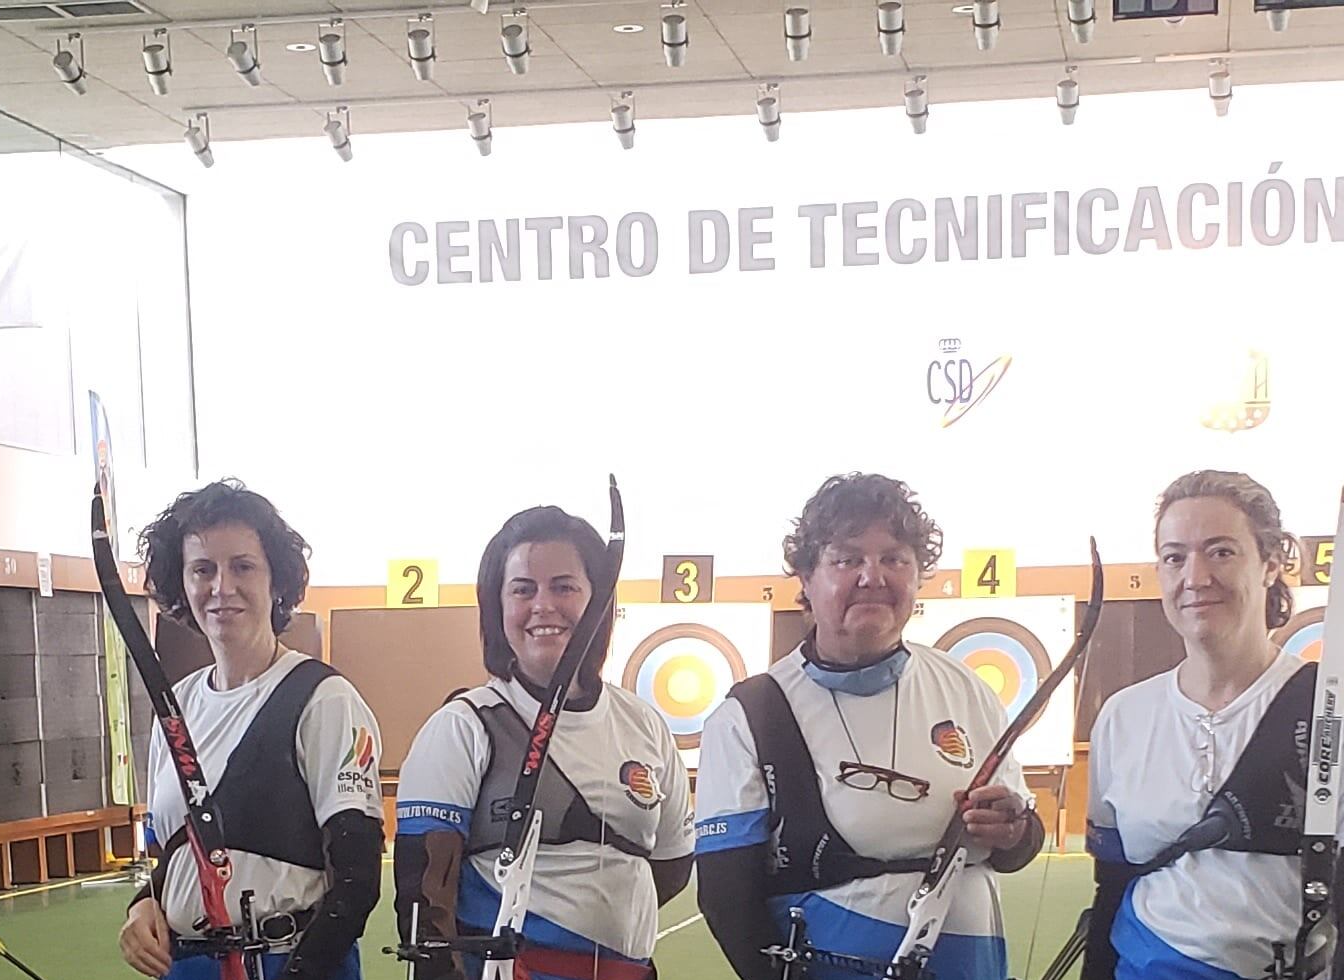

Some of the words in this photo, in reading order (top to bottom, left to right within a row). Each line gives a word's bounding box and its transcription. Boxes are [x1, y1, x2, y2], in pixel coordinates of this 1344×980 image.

[389, 211, 659, 286] CENTRO
[688, 206, 776, 275] DE
[927, 358, 973, 404] CSD
[673, 560, 698, 603] 3
[977, 554, 1000, 594] 4
[1130, 576, 1142, 590] 5
[1313, 542, 1335, 584] 5
[402, 565, 424, 605] 2
[763, 587, 774, 602] 3
[1318, 739, 1333, 783] CORE
